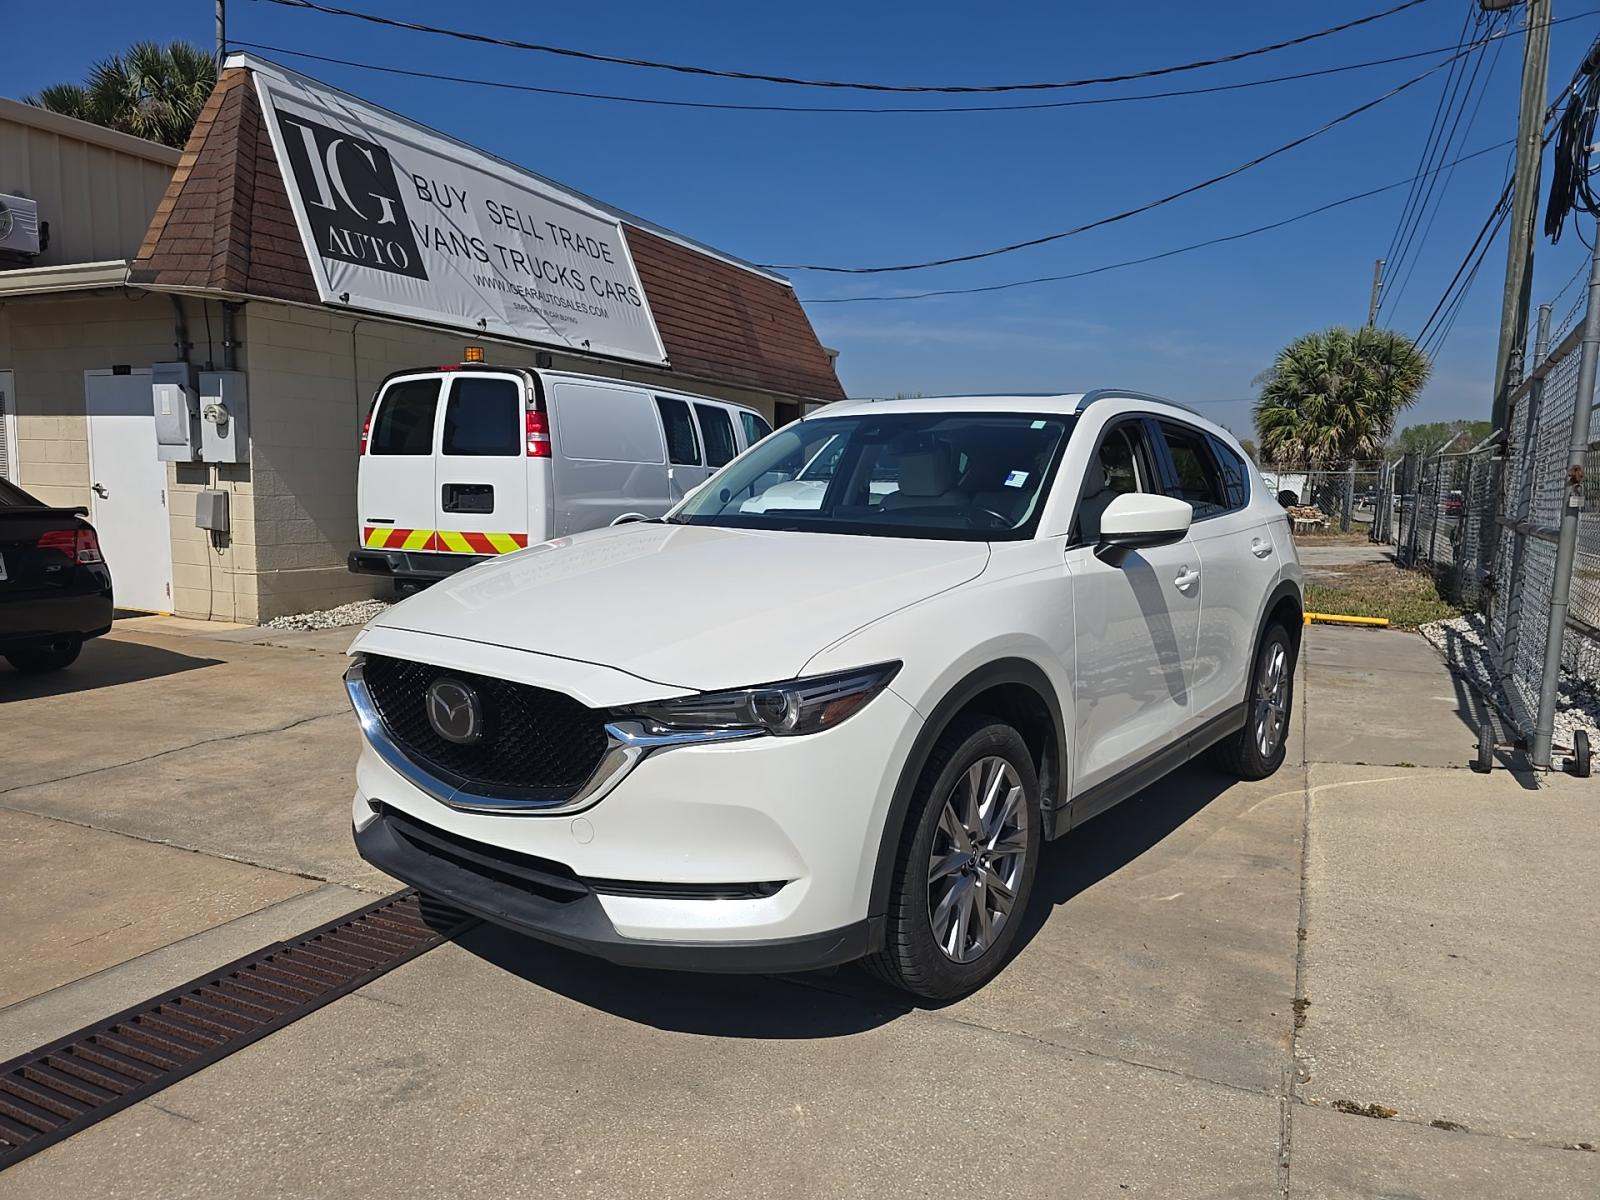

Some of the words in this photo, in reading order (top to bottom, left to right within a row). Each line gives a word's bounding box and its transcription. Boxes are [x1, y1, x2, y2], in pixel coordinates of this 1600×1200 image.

[285, 119, 397, 226] IG
[328, 225, 409, 269] AUTO
[410, 219, 490, 263] VANS
[493, 243, 586, 292] TRUCKS
[590, 275, 642, 307] CARS
[412, 173, 467, 214] BUY
[485, 199, 544, 241] SELL
[545, 221, 615, 265] TRADE
